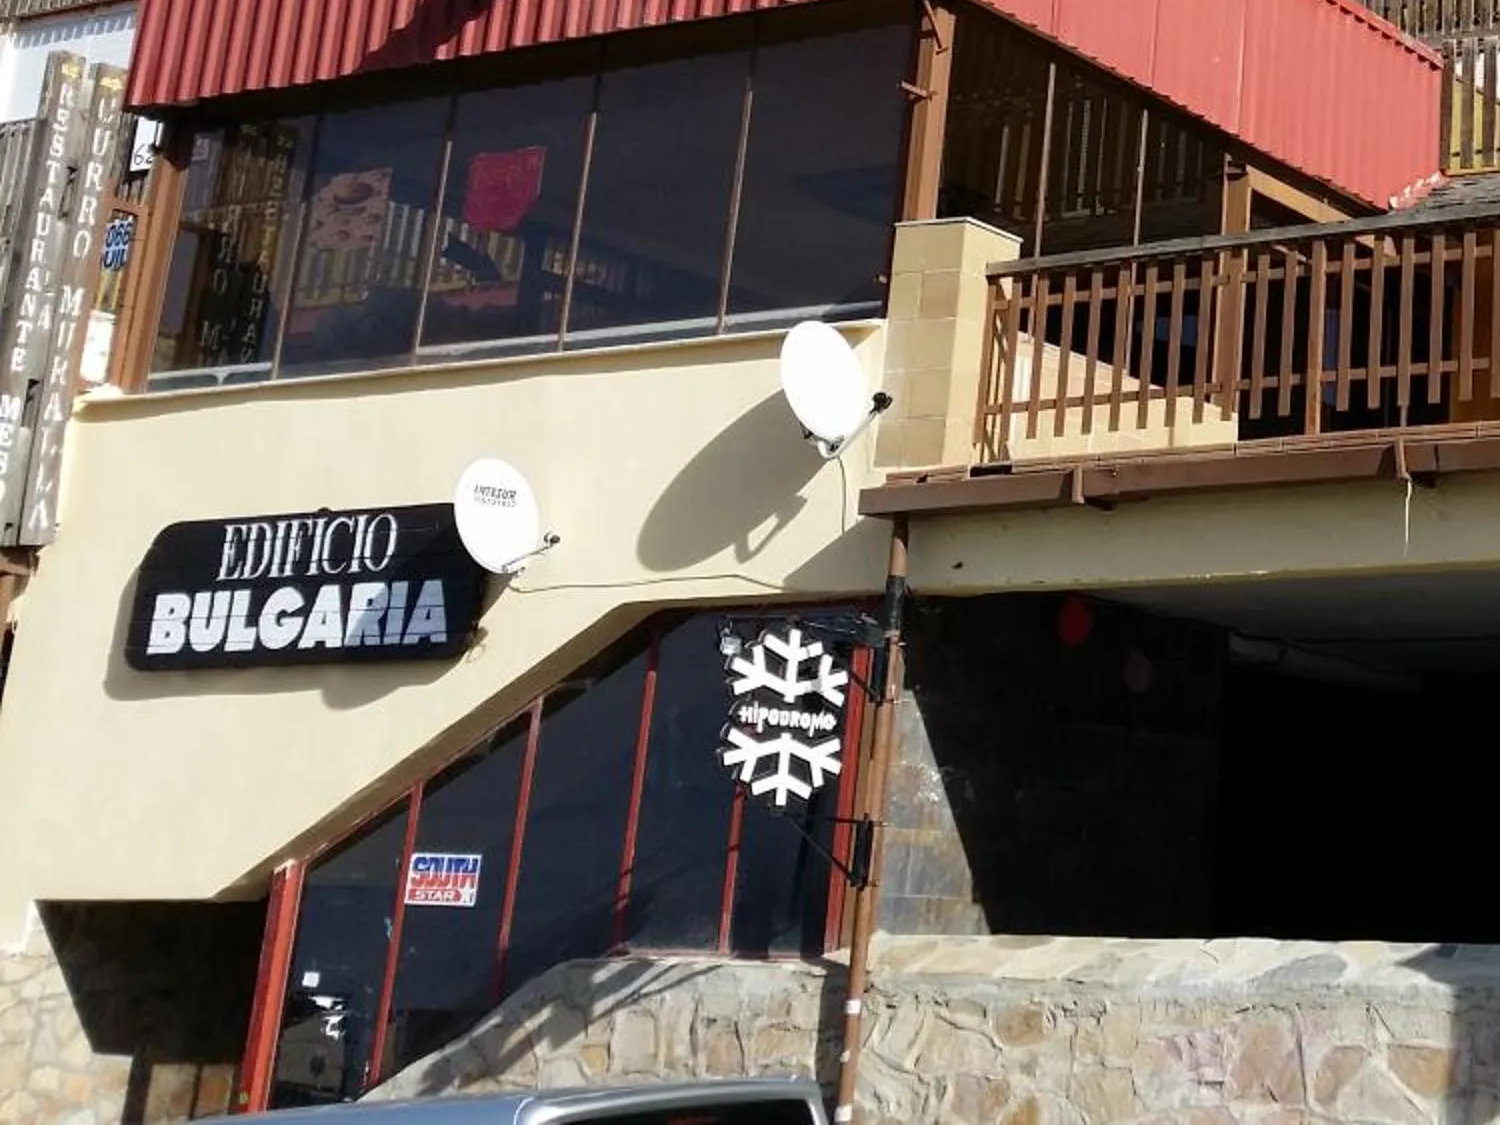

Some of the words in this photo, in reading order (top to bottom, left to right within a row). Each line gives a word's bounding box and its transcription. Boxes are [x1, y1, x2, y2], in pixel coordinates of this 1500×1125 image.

[11, 83, 74, 372] RESTAURANTE
[215, 513, 398, 582] EDIFICIO
[145, 579, 448, 656] BULGARIA
[411, 856, 479, 888] SOUTH
[414, 888, 455, 901] STAR
